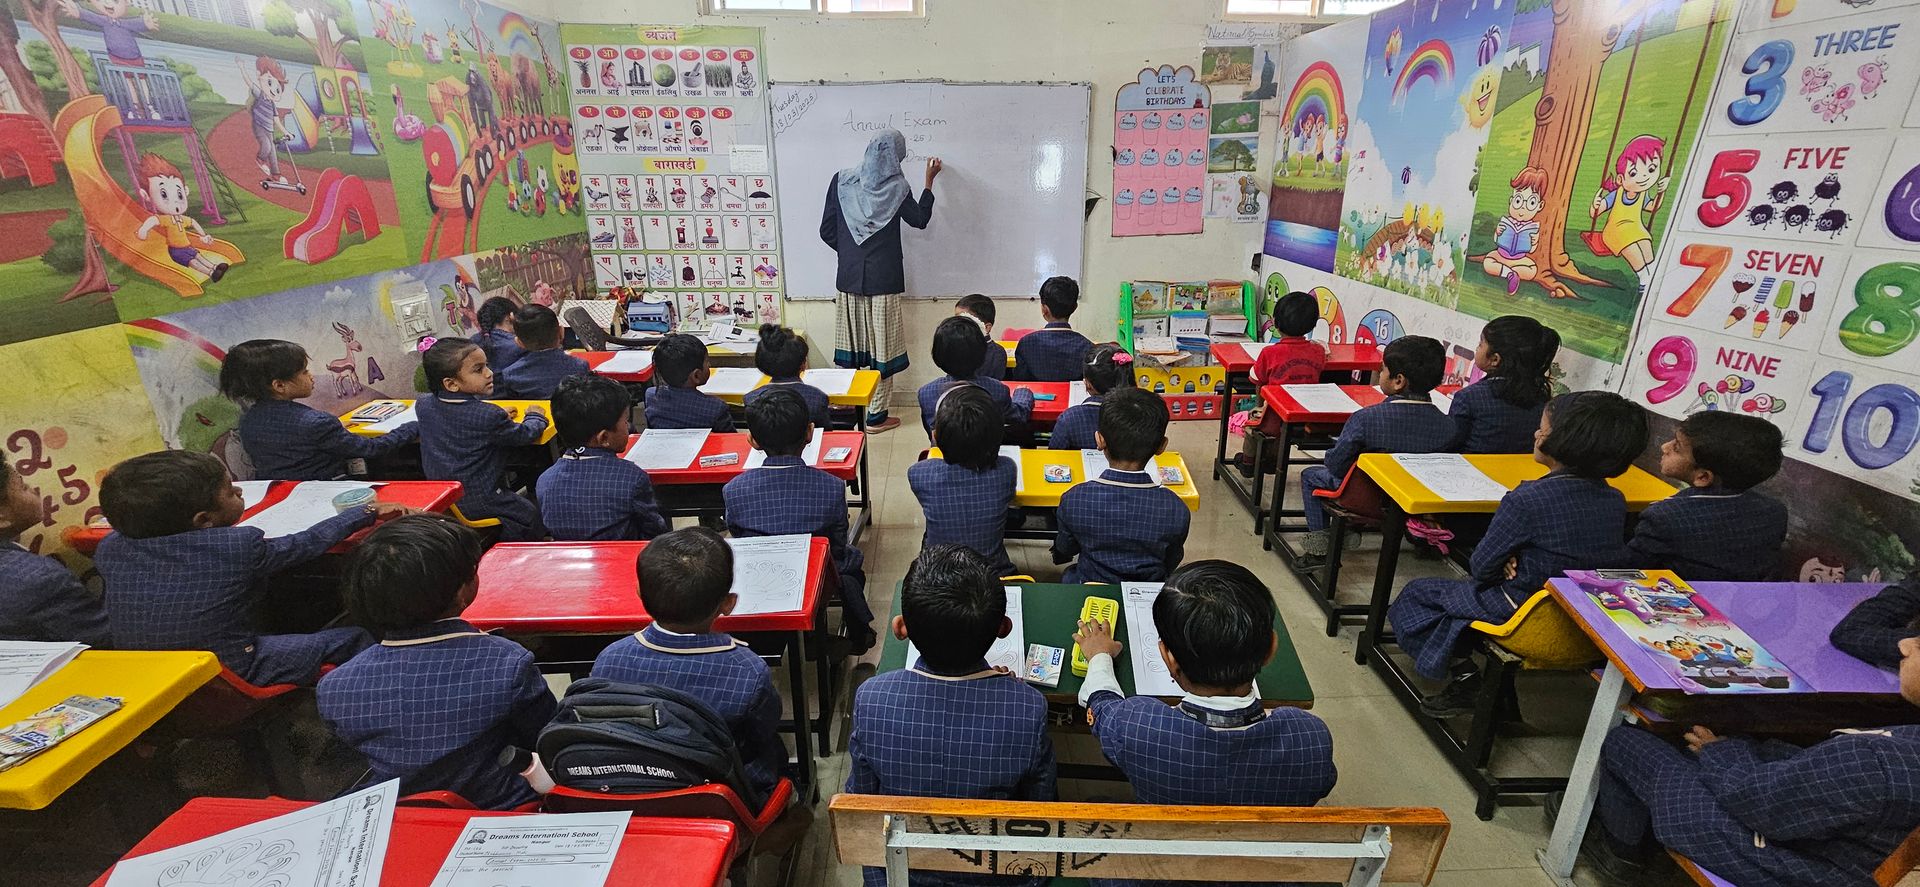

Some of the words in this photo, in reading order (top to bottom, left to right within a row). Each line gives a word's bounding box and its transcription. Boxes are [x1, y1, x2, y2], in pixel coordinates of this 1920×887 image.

[1813, 23, 1900, 57] THREE
[1727, 39, 1795, 126] 3
[772, 90, 800, 113] Tuesday
[1146, 97, 1186, 106] BIRTHDAYS
[904, 112, 947, 127] Exam
[653, 157, 696, 170] बाराखडी
[1784, 147, 1850, 169] FIVE
[589, 178, 600, 186] क
[616, 178, 628, 186] ख
[1697, 149, 1760, 228] 5
[595, 218, 606, 227] ज
[601, 257, 611, 265] ण
[1744, 250, 1824, 278] SEVEN
[1666, 243, 1733, 317] 7
[763, 294, 773, 302] ल
[1839, 262, 1920, 357] 8
[1332, 324, 1342, 345] 8
[1374, 316, 1389, 340] 16
[367, 356, 385, 384] A
[1646, 335, 1698, 404] 9
[1716, 347, 1781, 378] NINE
[1802, 370, 1920, 469] 10
[7, 429, 52, 476] 2
[57, 464, 91, 505] 5
[567, 766, 593, 775] DREAMS
[592, 764, 647, 776] INTERNATIONAL
[646, 766, 678, 779] SCHOOL
[362, 808, 374, 833] Dreams
